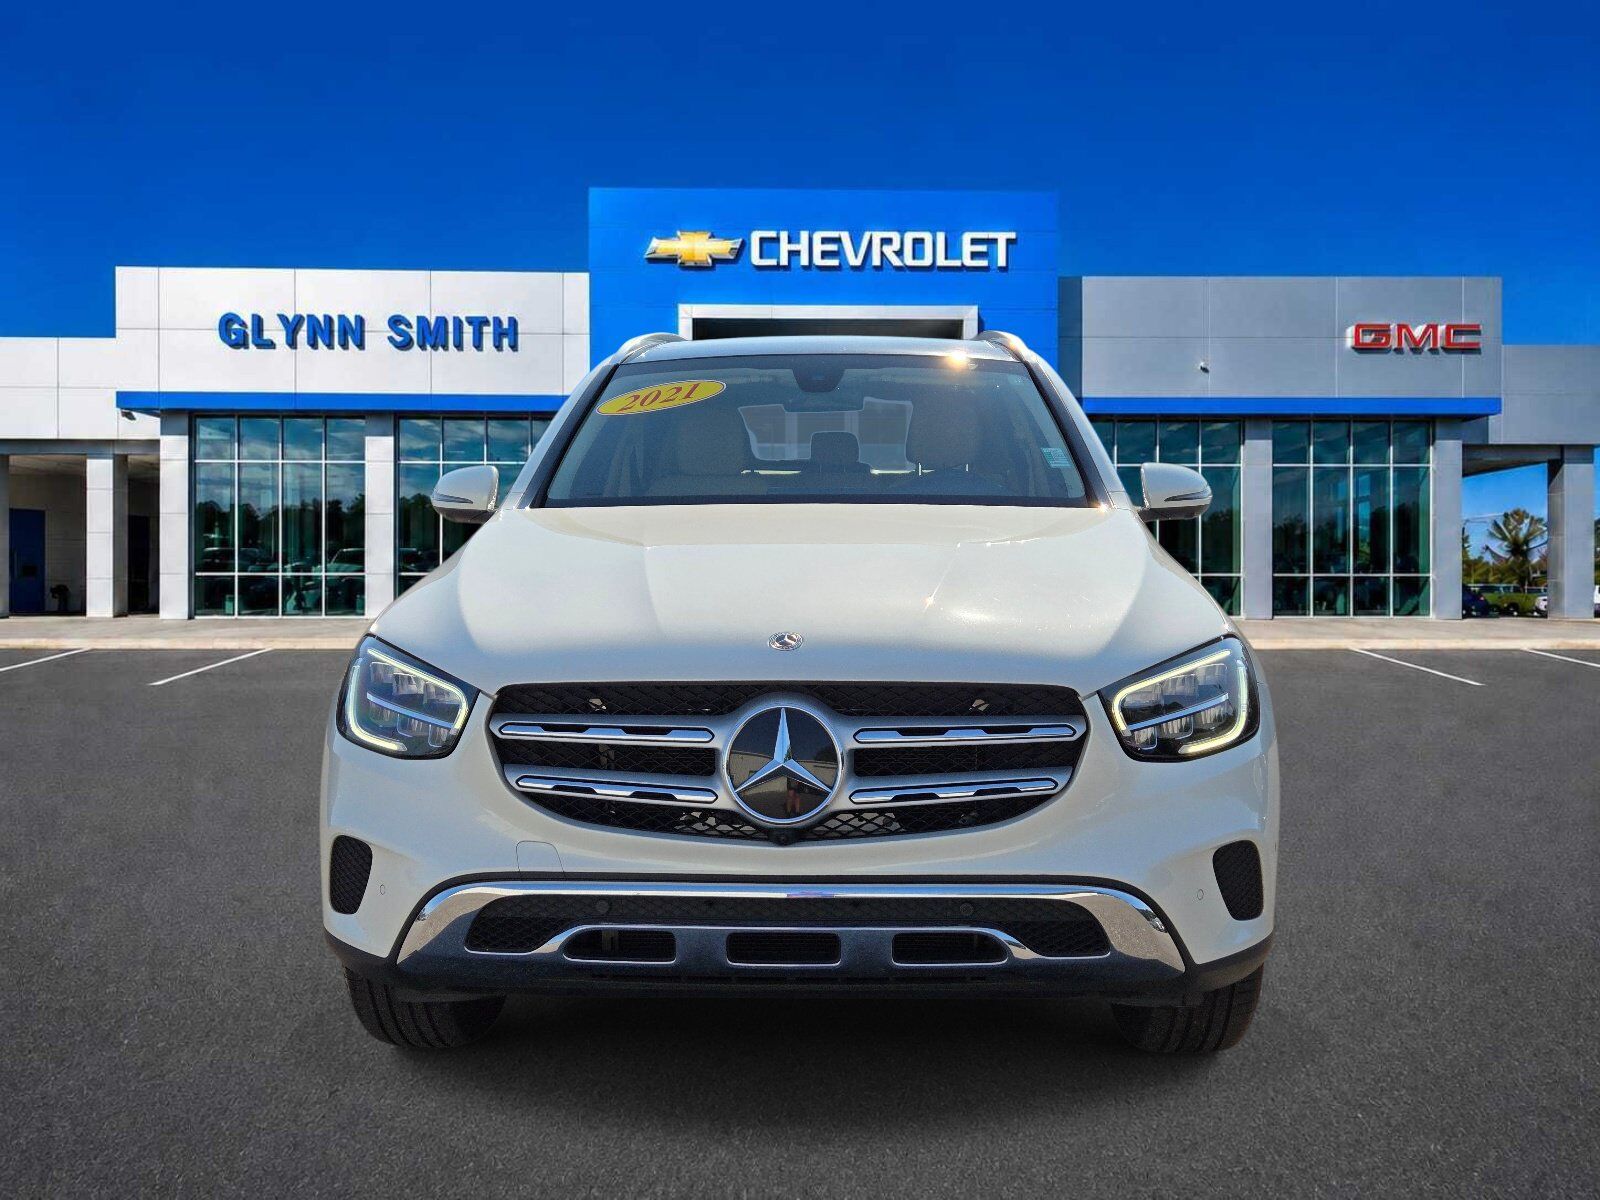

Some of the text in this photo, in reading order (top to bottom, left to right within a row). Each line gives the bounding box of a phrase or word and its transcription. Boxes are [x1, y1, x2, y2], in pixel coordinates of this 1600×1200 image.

[750, 230, 1016, 269] CHEVROLET
[218, 312, 519, 352] GLYNN SMITH
[1348, 322, 1482, 351] GMC
[615, 382, 702, 413] 2021
